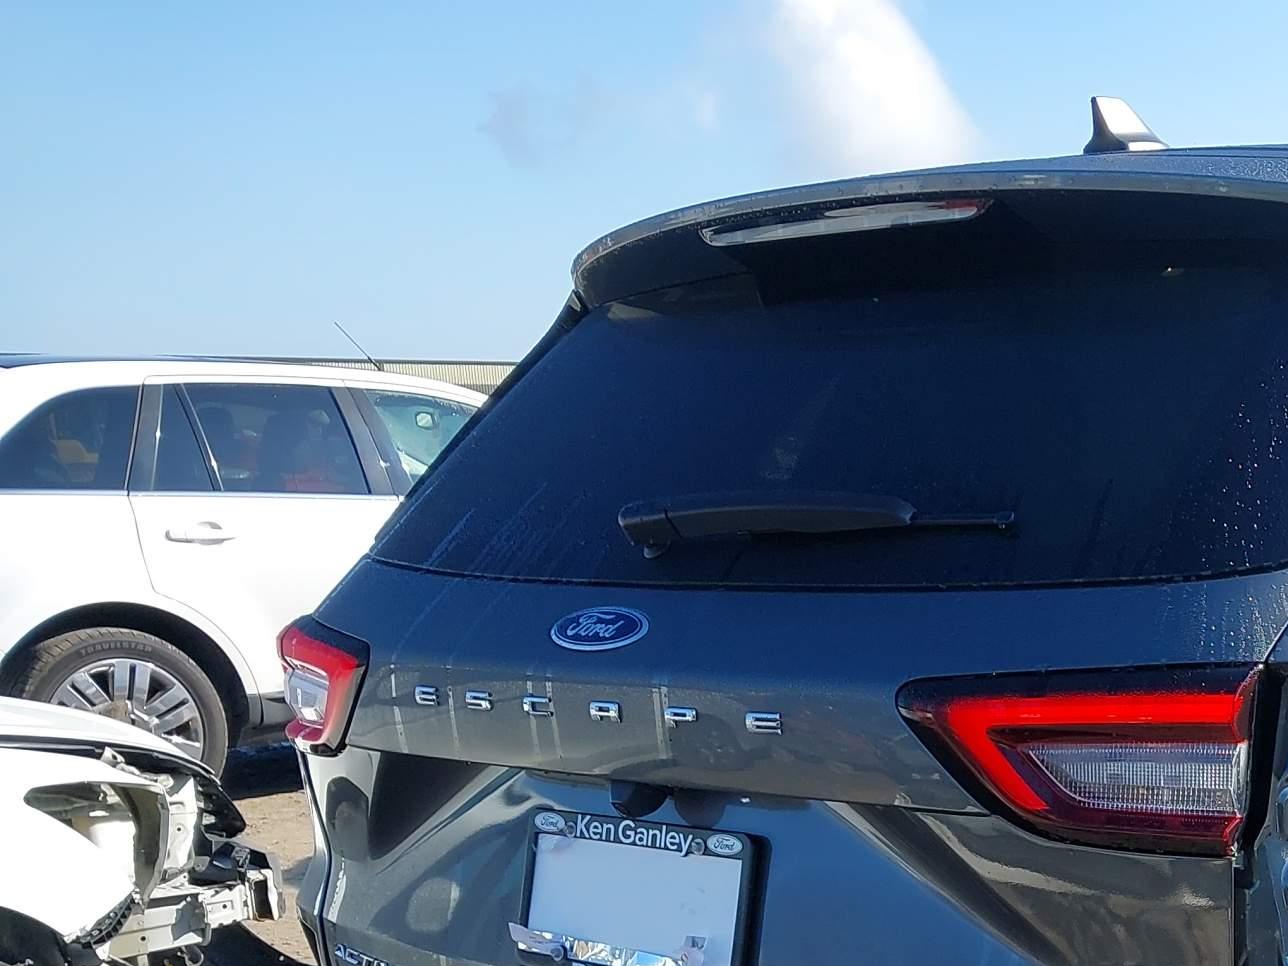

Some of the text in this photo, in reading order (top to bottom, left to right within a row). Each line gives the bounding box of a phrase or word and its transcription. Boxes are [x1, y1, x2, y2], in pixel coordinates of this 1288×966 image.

[566, 612, 624, 639] Ford
[79, 641, 153, 657] TRAVELSTAR
[414, 684, 783, 736] ESCAPE
[576, 814, 693, 858] Ken Ganley
